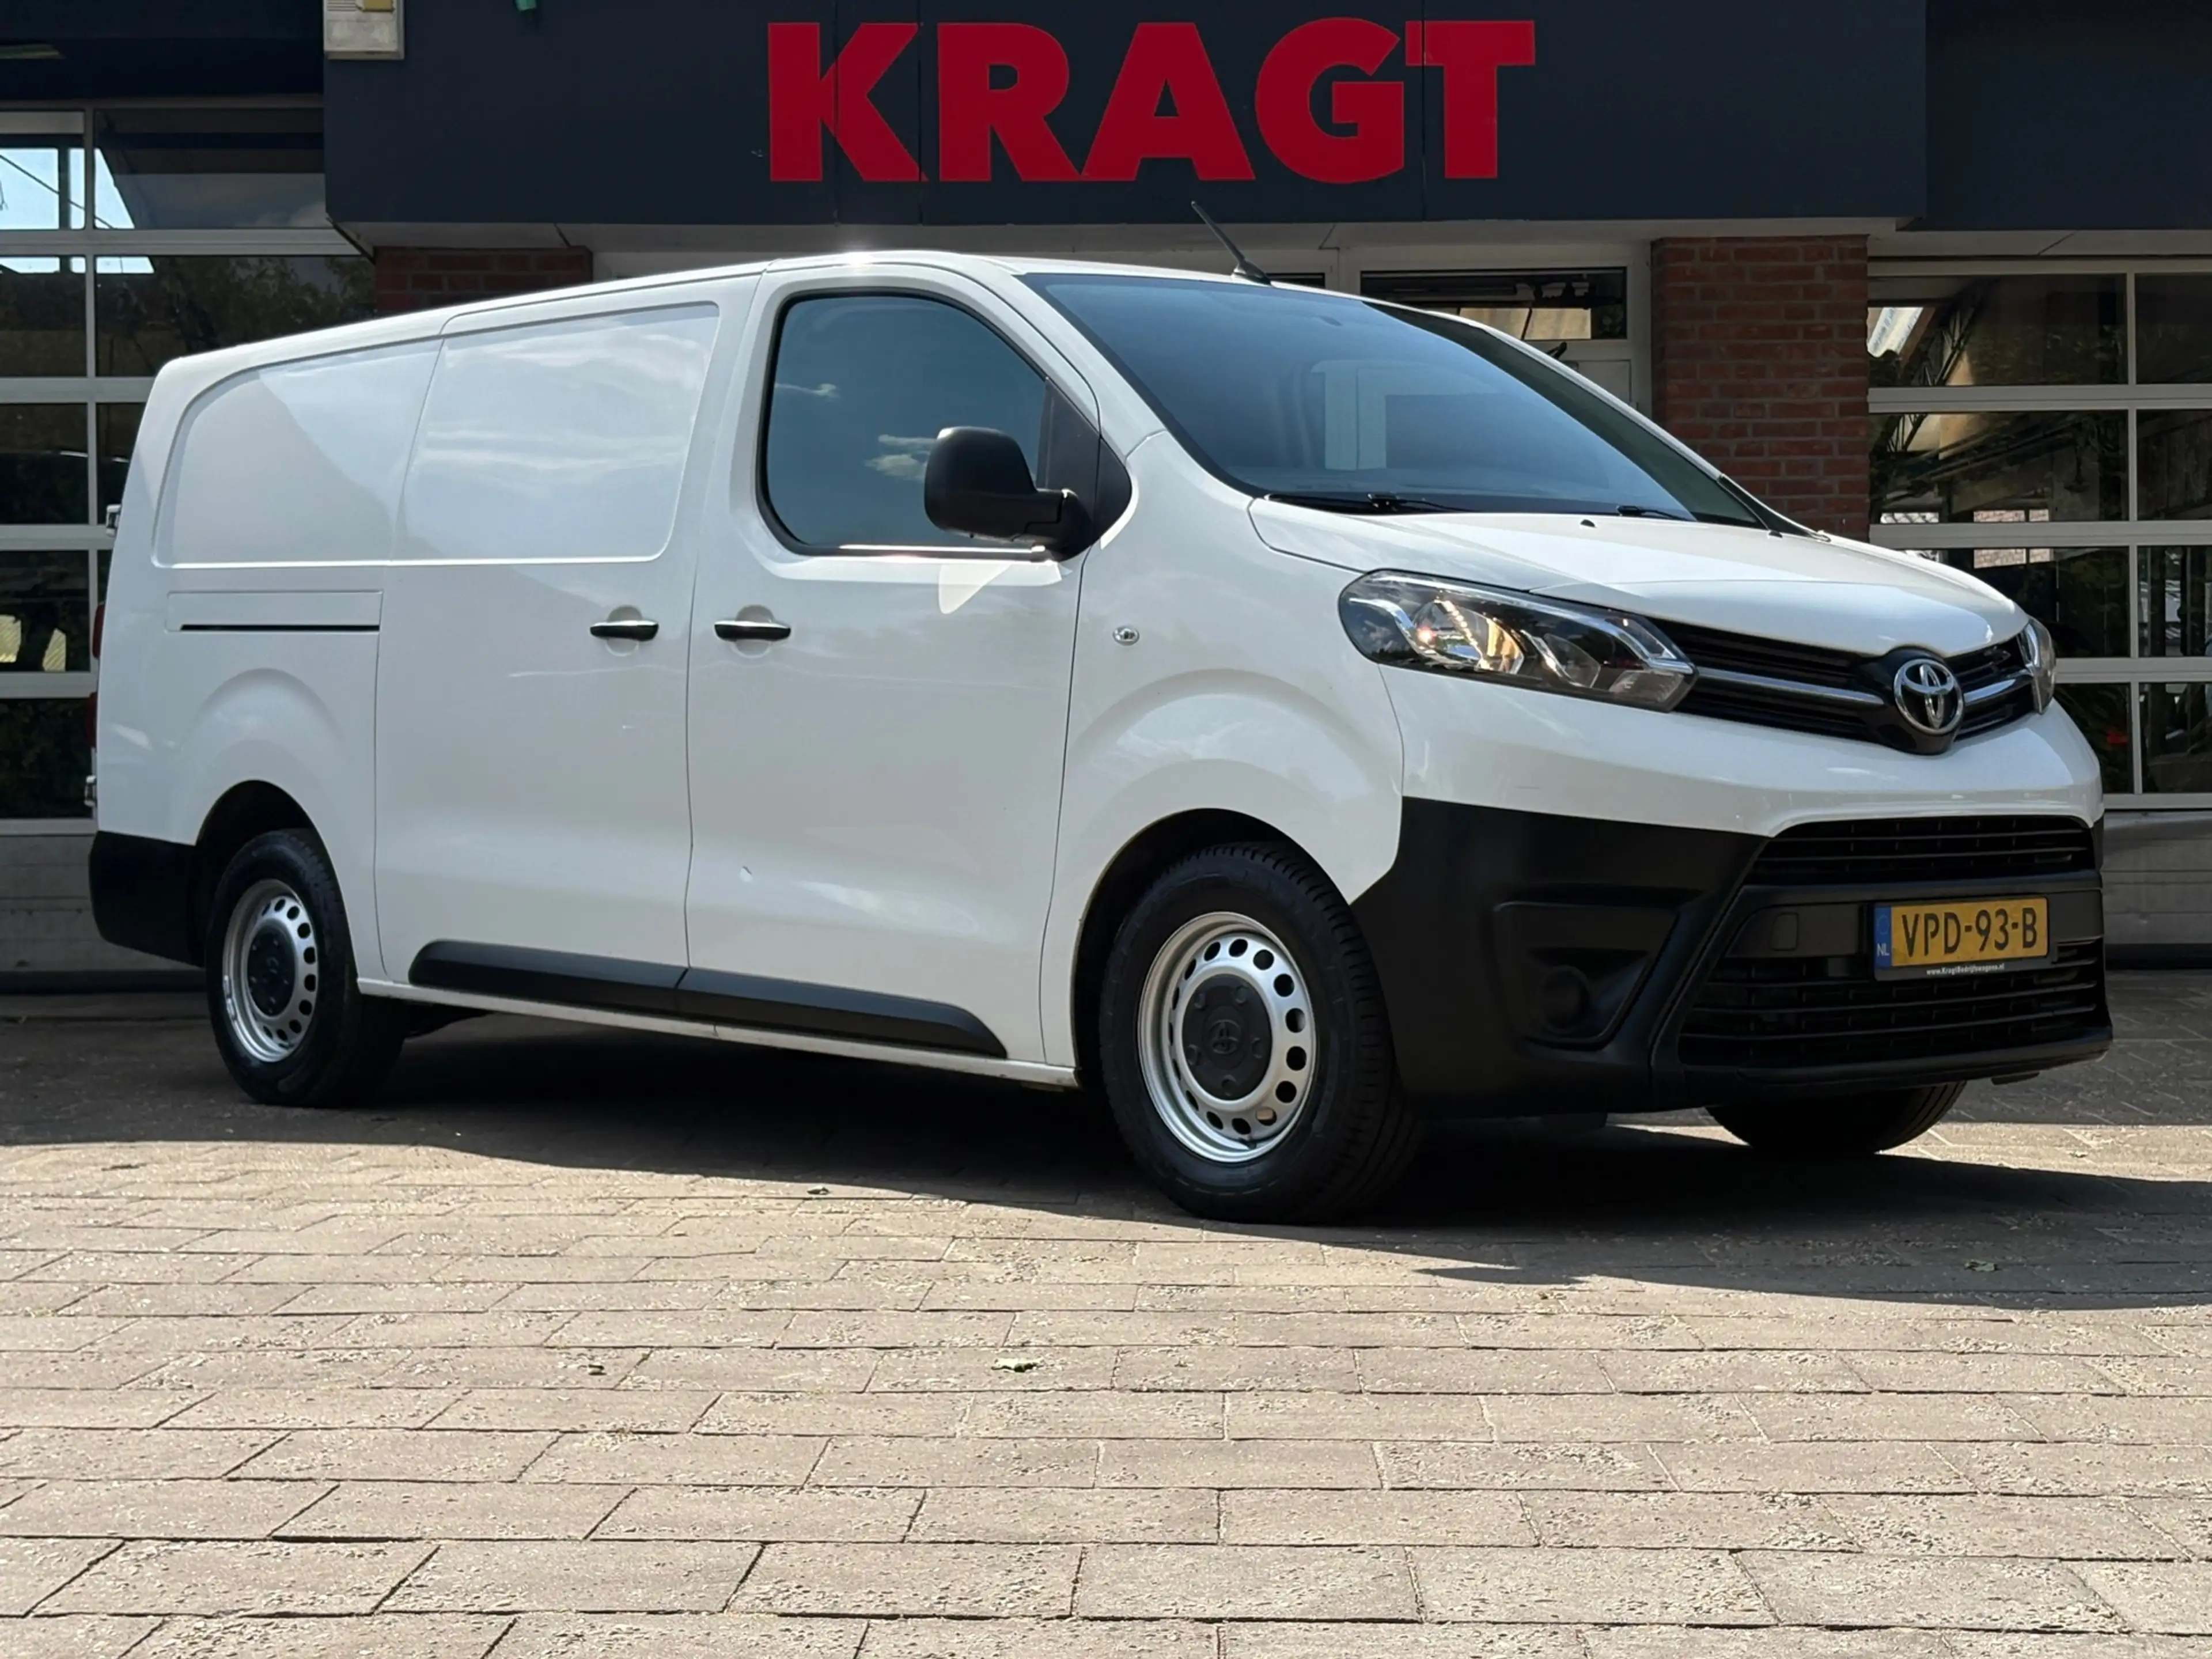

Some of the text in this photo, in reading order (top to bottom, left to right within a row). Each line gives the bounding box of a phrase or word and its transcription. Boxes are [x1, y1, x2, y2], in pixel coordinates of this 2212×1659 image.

[769, 19, 1534, 182] KRAGT
[1877, 942, 1890, 957] NL
[1902, 907, 2037, 958] VPD-93-B
